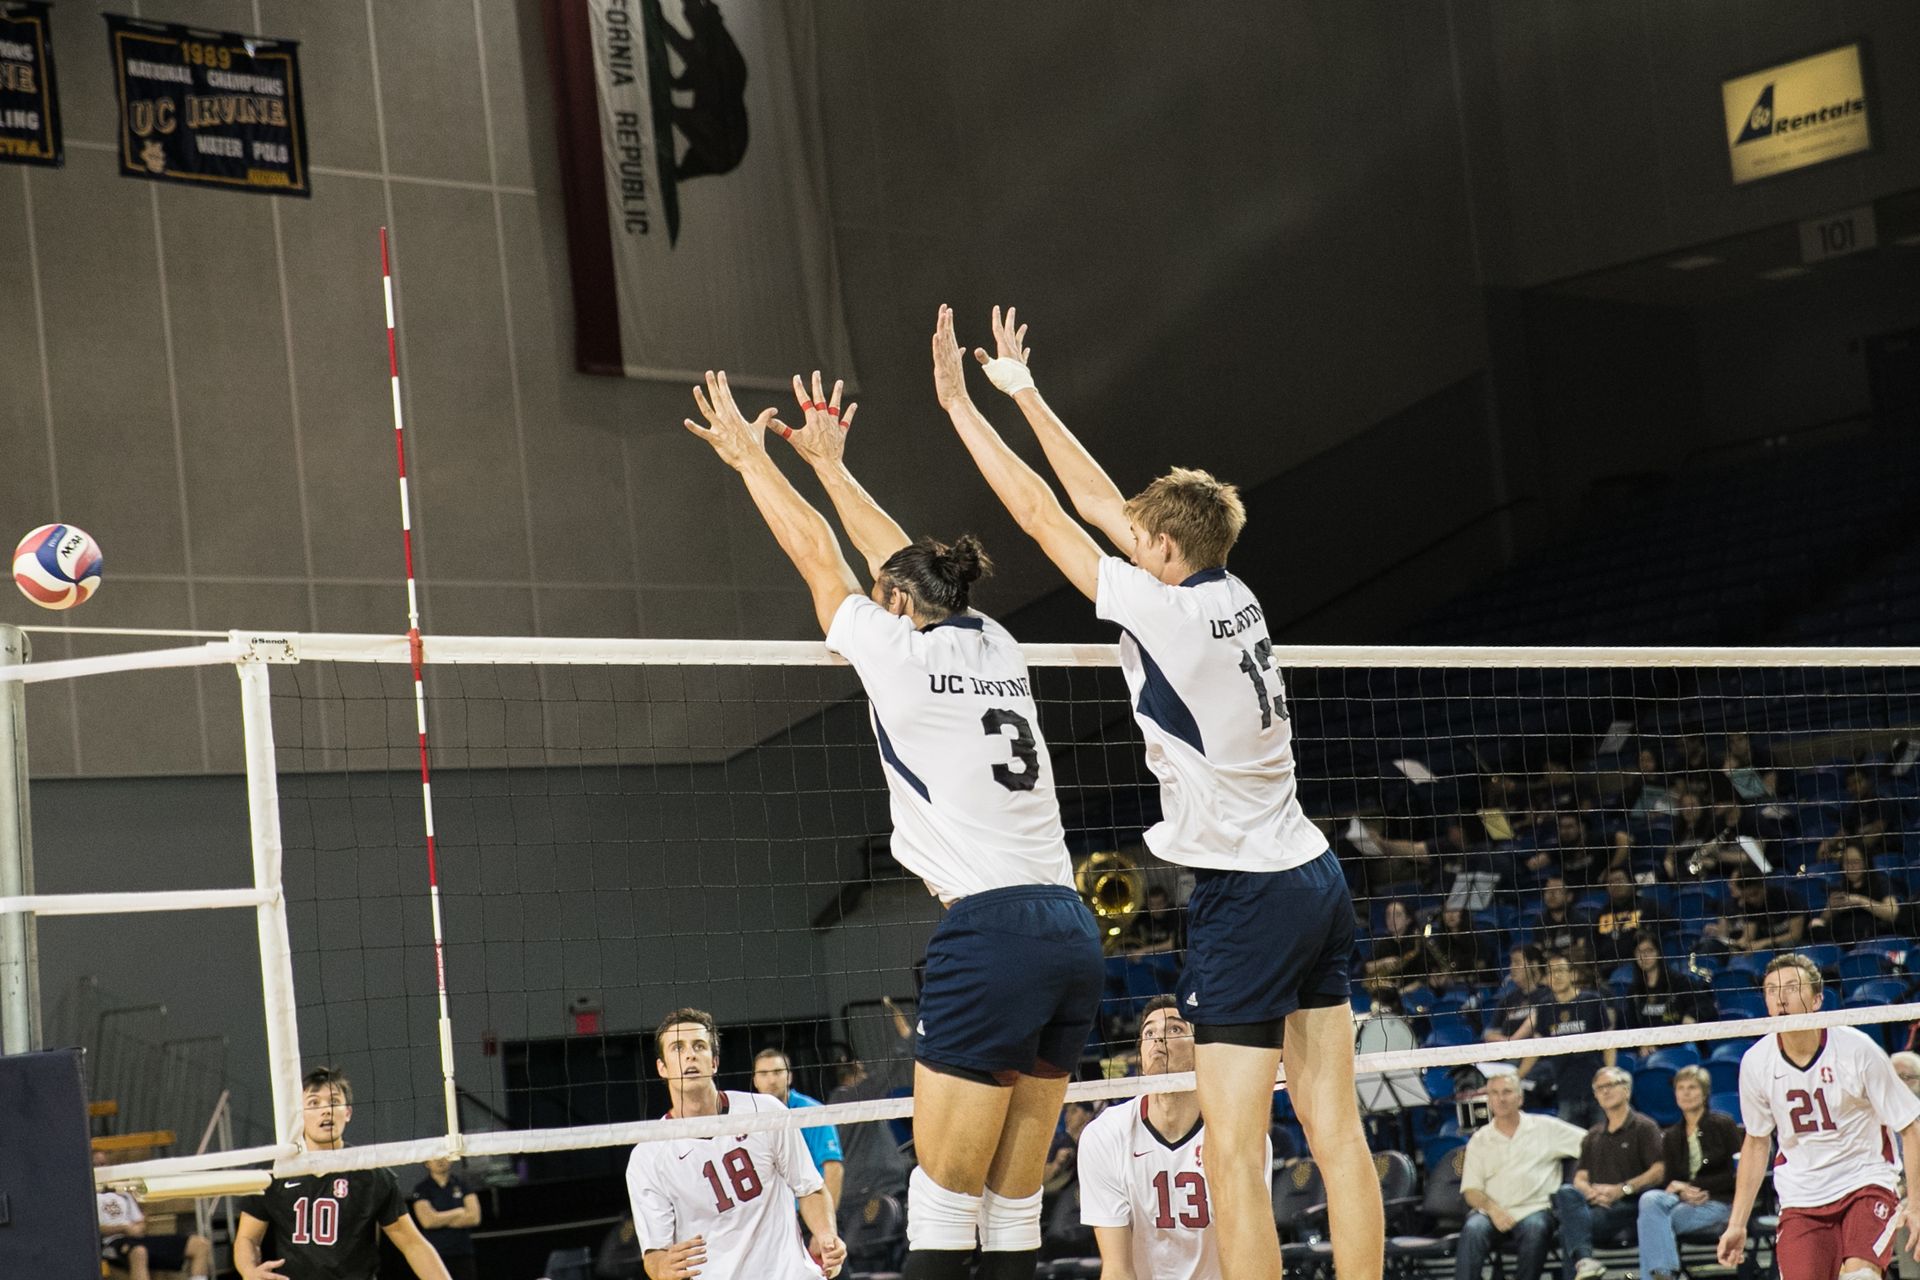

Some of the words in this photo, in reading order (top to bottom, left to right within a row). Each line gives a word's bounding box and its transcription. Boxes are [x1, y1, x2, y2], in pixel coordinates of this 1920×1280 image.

[181, 41, 231, 70] 1989
[129, 97, 176, 137] UC
[185, 94, 287, 128] IRVINE
[1775, 97, 1865, 134] Rentals
[195, 133, 243, 159] WATER
[252, 141, 289, 164] POLO
[615, 111, 649, 236] REPUBLIC
[1817, 218, 1856, 255] 101
[1209, 619, 1236, 639] UC
[928, 674, 965, 694] UC
[981, 707, 1040, 792] 3
[1785, 1087, 1838, 1134] 21
[702, 1146, 764, 1214] 18
[1152, 1170, 1211, 1229] 13
[292, 1196, 340, 1246] 10
